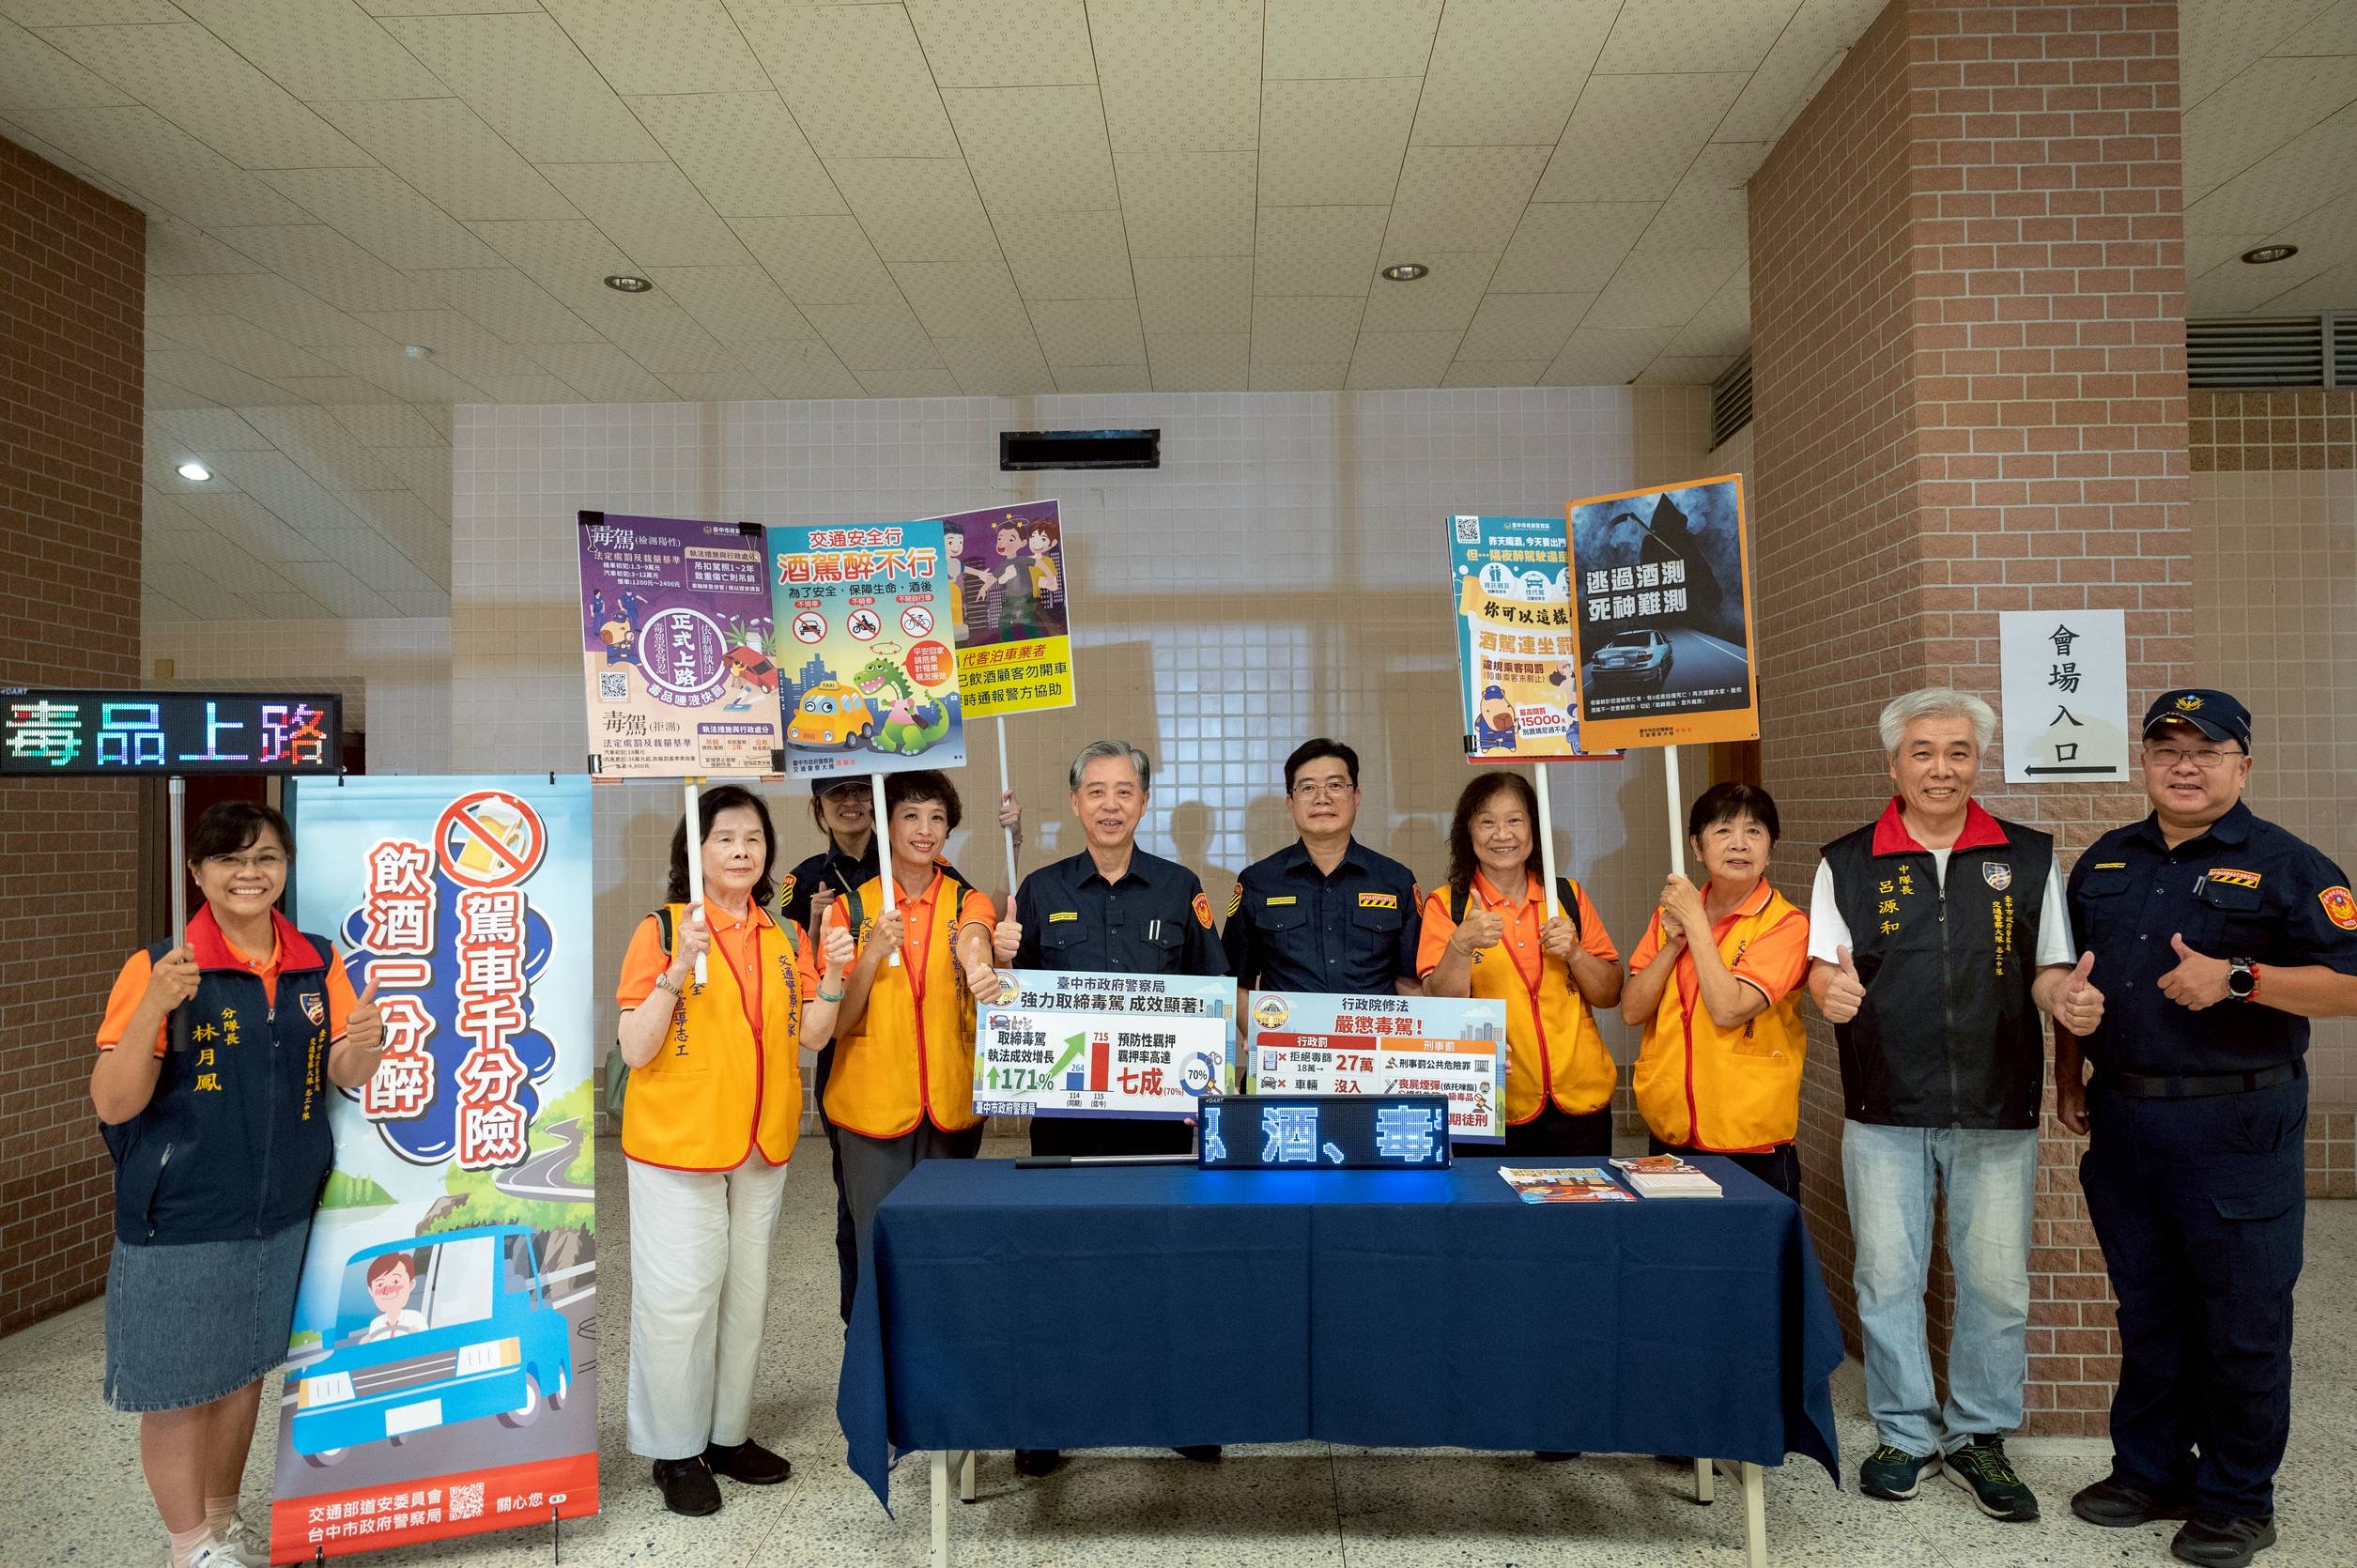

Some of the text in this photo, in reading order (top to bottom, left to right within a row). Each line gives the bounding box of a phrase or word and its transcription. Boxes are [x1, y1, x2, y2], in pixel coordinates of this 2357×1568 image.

[809, 529, 901, 548] 交通安全行
[778, 548, 937, 585] 酒駕醉不行
[1585, 559, 1686, 595] 逃過酒測
[1484, 601, 1571, 625] 你可以這樣
[1588, 588, 1687, 623] 死神難測
[670, 614, 698, 687] 正式上路
[959, 682, 1061, 707] 時通報警方協助
[2048, 623, 2084, 762] 會場入口
[6, 699, 327, 767] 毒品上路
[1899, 864, 1915, 896] 中隊長
[1878, 880, 1901, 935] 呂源和
[371, 843, 434, 1114] 飲酒一分醉
[1057, 976, 1165, 993] 臺中市政府警察局
[1020, 992, 1206, 1014] 強力取締毒駕 成效顯著!
[1343, 997, 1409, 1013] 行政院修法
[222, 1007, 240, 1045] 分隊長
[462, 891, 525, 1168] 駕車千分險
[1093, 1032, 1109, 1042] 715
[997, 1031, 1046, 1047] 取締毒駕
[1117, 1033, 1176, 1049] 預防性羈押
[1297, 1037, 1328, 1048] 行政罰
[1424, 1040, 1456, 1053] 刑事罰
[192, 1023, 222, 1093] 林月鳳
[988, 1049, 1055, 1065] 執法成效增長
[1071, 1064, 1085, 1072] 264
[1117, 1049, 1172, 1065] 羈押率高達
[1289, 1052, 1374, 1072] 拒絕毒篩 27萬
[1398, 1058, 1471, 1070] 刑事罰公共危險罪
[1000, 1068, 1054, 1091] 171%
[1187, 1069, 1208, 1080] 70%
[1294, 1079, 1362, 1095] 車輛 沒入
[975, 1101, 1037, 1115] 臺中市政府警察局
[1448, 1112, 1488, 1127] 期徒刑
[308, 1488, 443, 1524] 交通部道安委員會
[496, 1492, 544, 1514] 關心您
[308, 1507, 441, 1544] 台中市政府警察局
